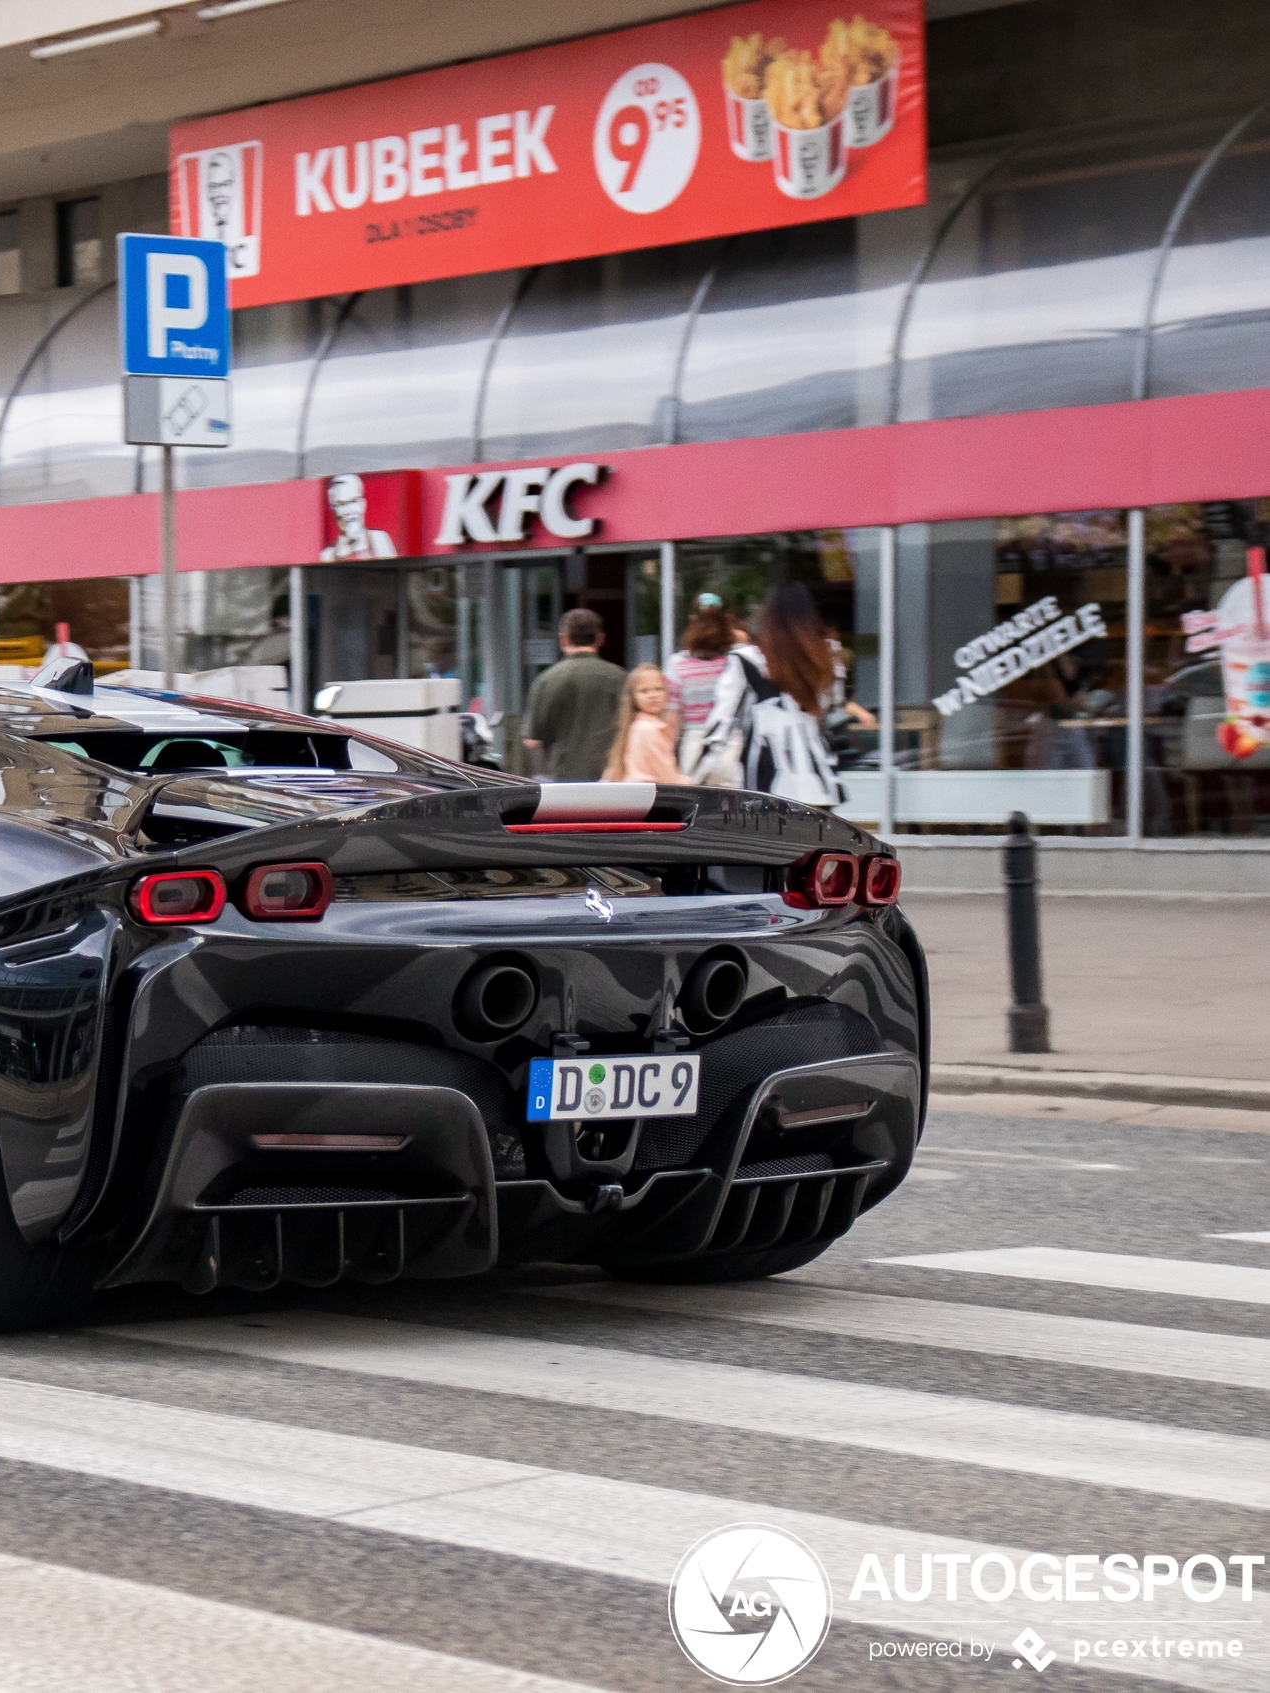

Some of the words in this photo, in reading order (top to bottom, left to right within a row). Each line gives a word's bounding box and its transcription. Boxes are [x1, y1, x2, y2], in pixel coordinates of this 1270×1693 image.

[294, 104, 559, 217] KUBEŁEK
[146, 252, 209, 359] P
[434, 462, 598, 545] KFC
[953, 595, 1062, 669] OTWARTE
[556, 1066, 584, 1112] D
[671, 1061, 694, 1107] 9
